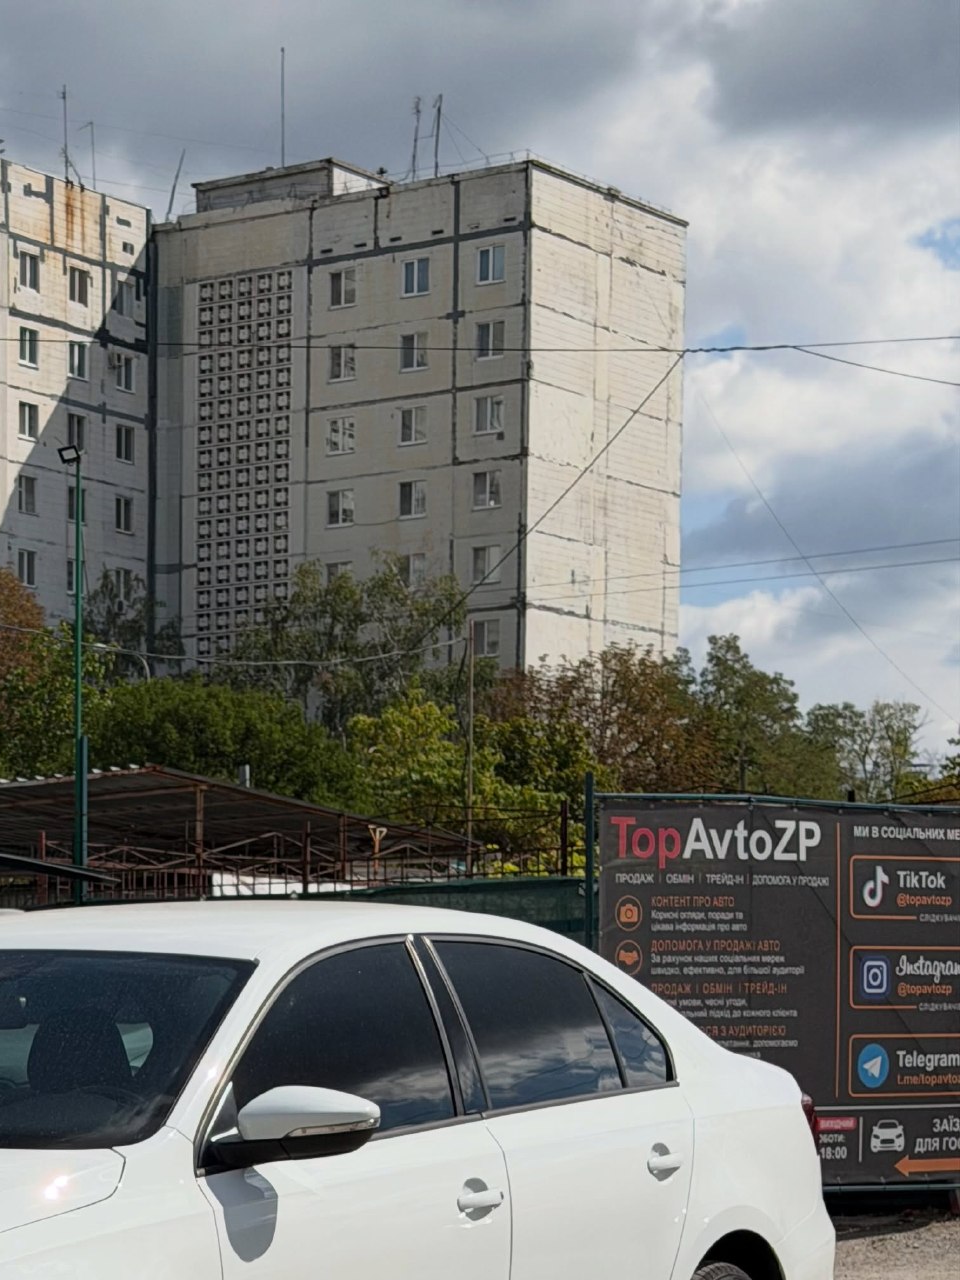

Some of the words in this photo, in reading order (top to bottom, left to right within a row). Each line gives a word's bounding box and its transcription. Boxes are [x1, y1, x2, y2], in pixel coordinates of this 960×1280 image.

[853, 825, 870, 838] МИ
[871, 826, 880, 838] В
[881, 826, 945, 841] СОЦІАЛЬНИХ
[610, 816, 822, 869] TopAvtoZP
[615, 872, 655, 884] ПРОДАЖ
[666, 873, 694, 884] ОБМІН
[752, 873, 790, 886] ДОПОМОГА
[896, 870, 946, 889] TikTok
[651, 896, 692, 908] КОНТЕНТ
[692, 896, 712, 908] ПРО
[712, 896, 735, 908] АВТО
[896, 893, 953, 908] @topavtozp
[650, 940, 703, 953] ДОПОМОГА
[757, 940, 781, 951] АВТО
[702, 983, 733, 994] ОБМІН
[743, 982, 788, 996] ТРЕЙД-ІН
[897, 982, 953, 997] @topavtozp
[914, 1137, 940, 1154] ДЛЯ
